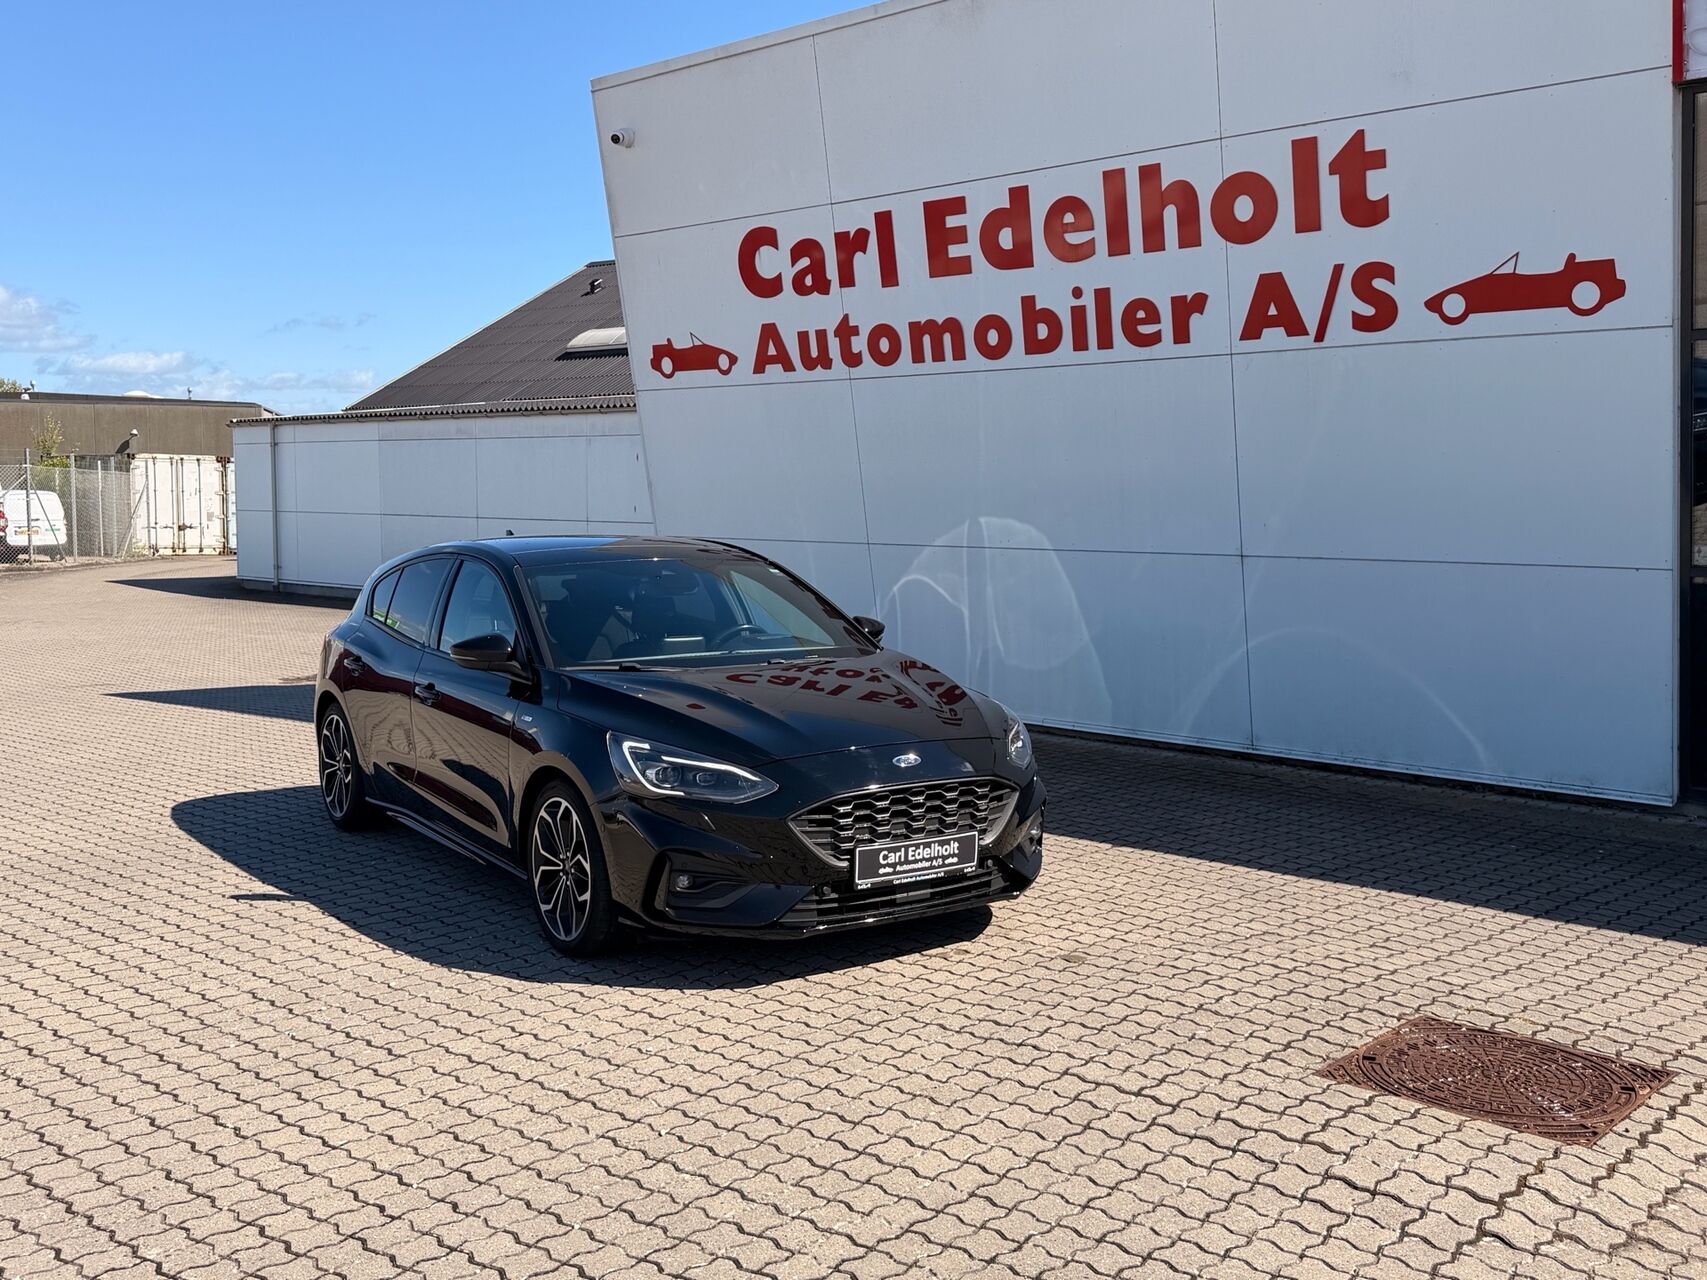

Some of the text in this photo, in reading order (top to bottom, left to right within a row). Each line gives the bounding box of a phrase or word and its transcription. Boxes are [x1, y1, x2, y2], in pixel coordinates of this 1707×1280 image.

[739, 131, 1390, 298] Carl Edelholt
[754, 262, 1397, 373] Automobiler A/S
[879, 841, 959, 864] Carl Edelholt
[896, 858, 943, 872] Automobiler A/S
